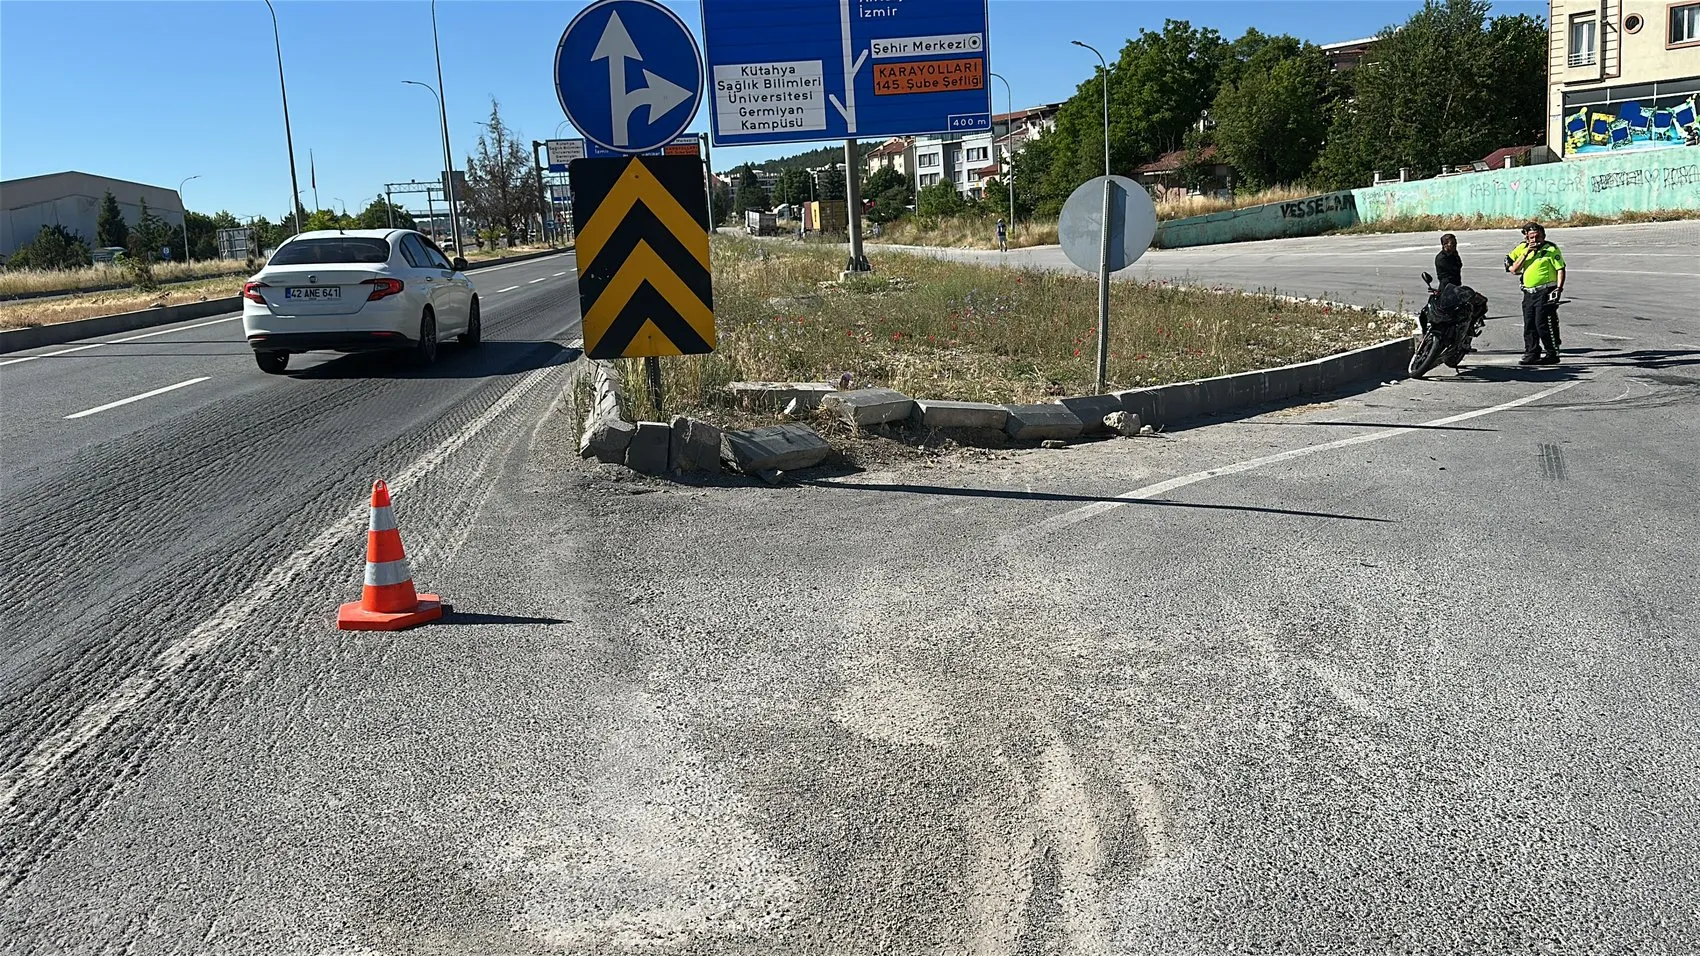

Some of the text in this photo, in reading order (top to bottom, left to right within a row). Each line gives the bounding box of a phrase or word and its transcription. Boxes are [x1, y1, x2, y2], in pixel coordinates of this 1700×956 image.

[860, 4, 898, 18] İzmir
[873, 38, 966, 55] Şehir Merkezi
[741, 65, 796, 77] Kütahya
[879, 62, 978, 78] KARAYOLLARI
[717, 76, 821, 93] Sağlık Bilimleri
[907, 78, 939, 90] Şube
[943, 74, 982, 88] Şefliği
[728, 91, 813, 104] Üniversitesi
[739, 106, 804, 118] Germiyan
[741, 118, 804, 131] Kampüsü
[953, 118, 974, 127] 400
[291, 289, 338, 298] 42 ANE 641
